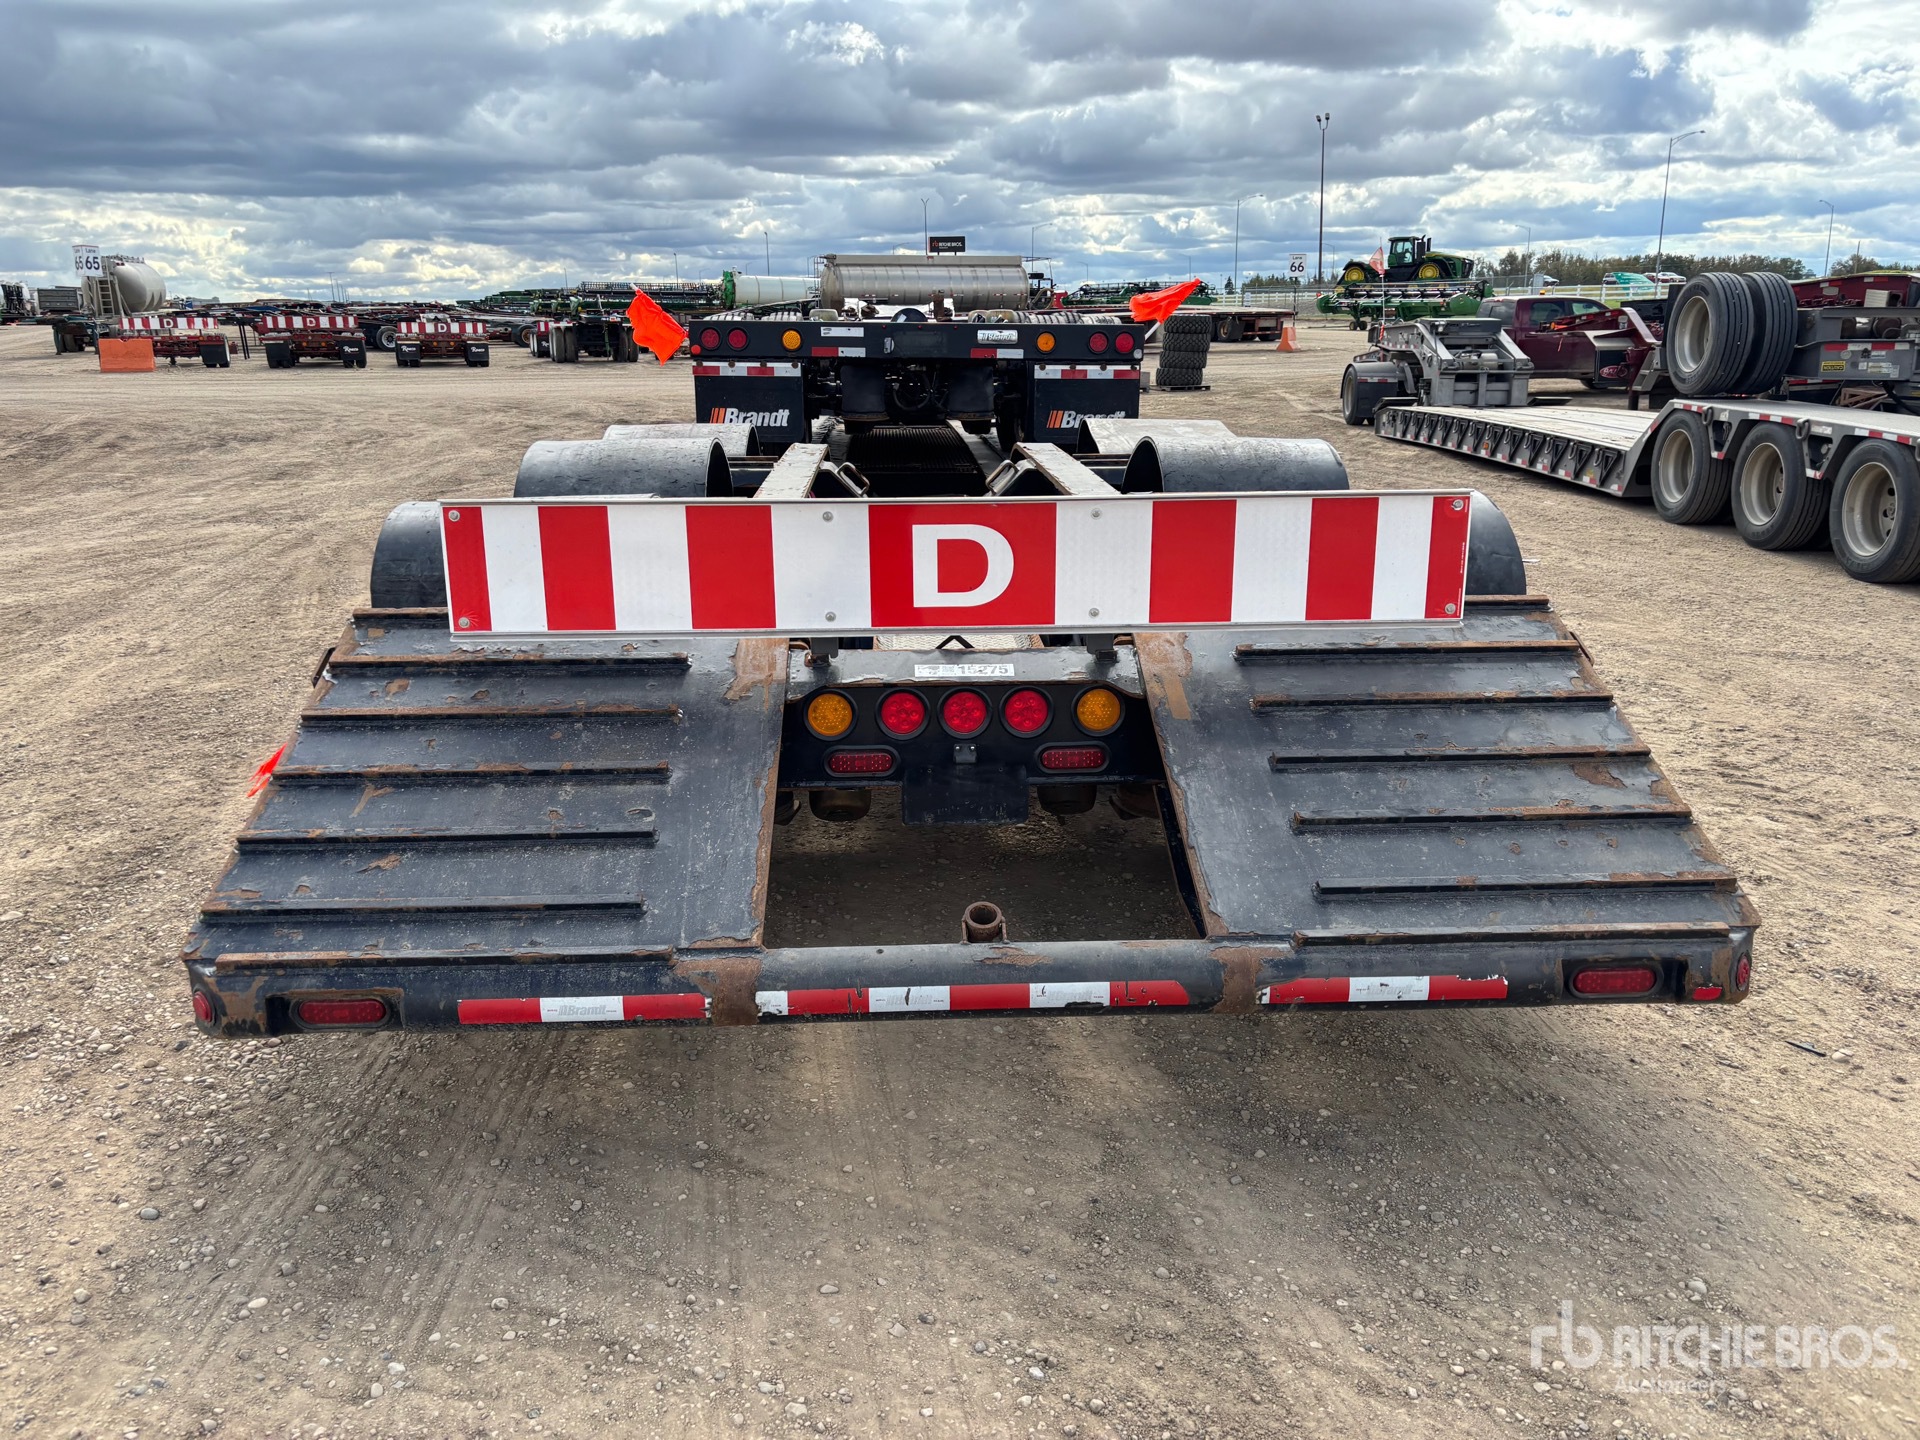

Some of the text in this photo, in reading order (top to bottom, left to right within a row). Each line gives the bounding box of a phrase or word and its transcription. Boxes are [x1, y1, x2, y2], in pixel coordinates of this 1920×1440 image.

[75, 256, 84, 270] 65
[85, 256, 100, 270] 65
[1290, 262, 1305, 272] 66
[163, 318, 174, 328] D
[306, 317, 316, 327] D
[437, 323, 447, 332] D
[724, 408, 790, 426] Brandt
[912, 524, 1014, 608] D
[958, 664, 1009, 675] 15275
[567, 1004, 607, 1016] Brandt
